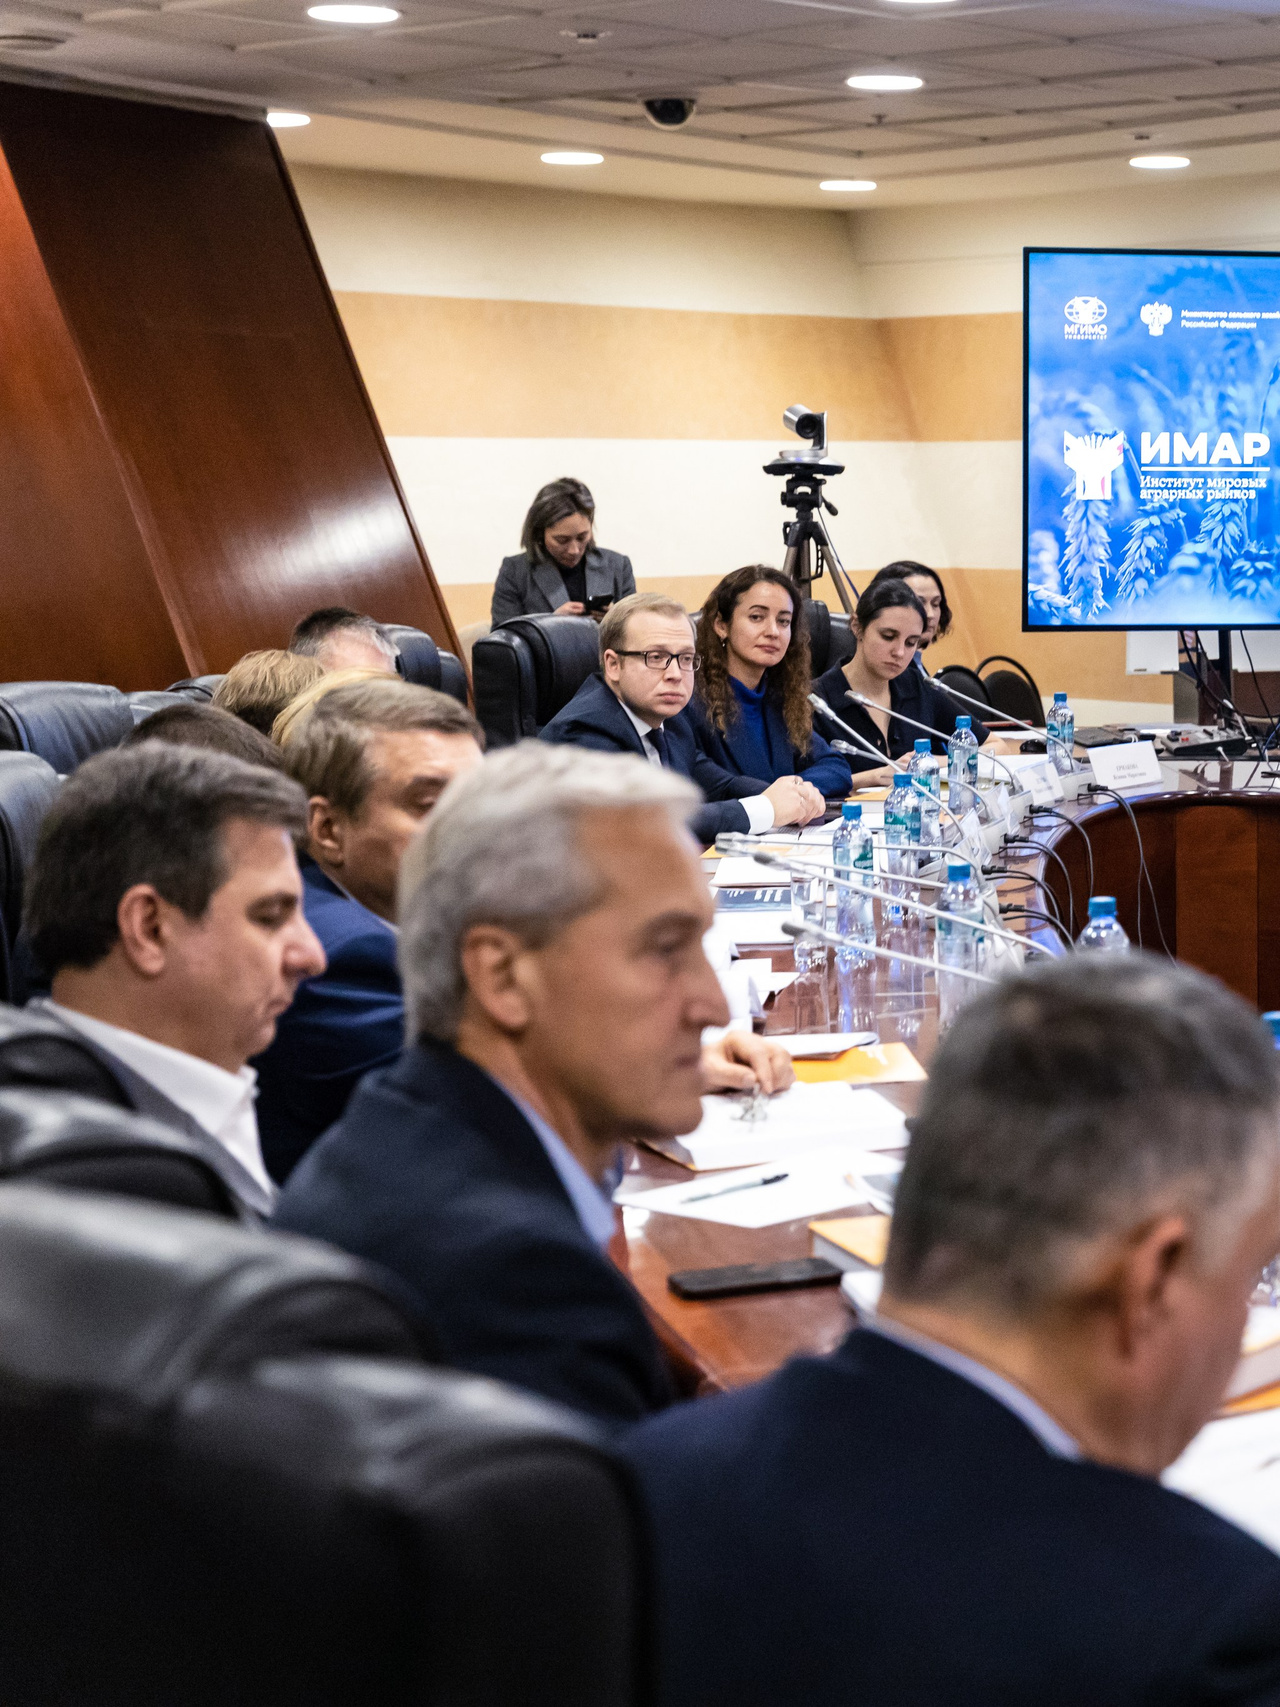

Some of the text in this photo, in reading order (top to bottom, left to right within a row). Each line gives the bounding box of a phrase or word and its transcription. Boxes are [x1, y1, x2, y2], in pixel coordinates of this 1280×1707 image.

[1064, 323, 1108, 335] МГИМО
[1140, 432, 1271, 465] ИМАР
[1139, 475, 1267, 490] Институт мировых
[1139, 488, 1257, 502] аграрных рынков
